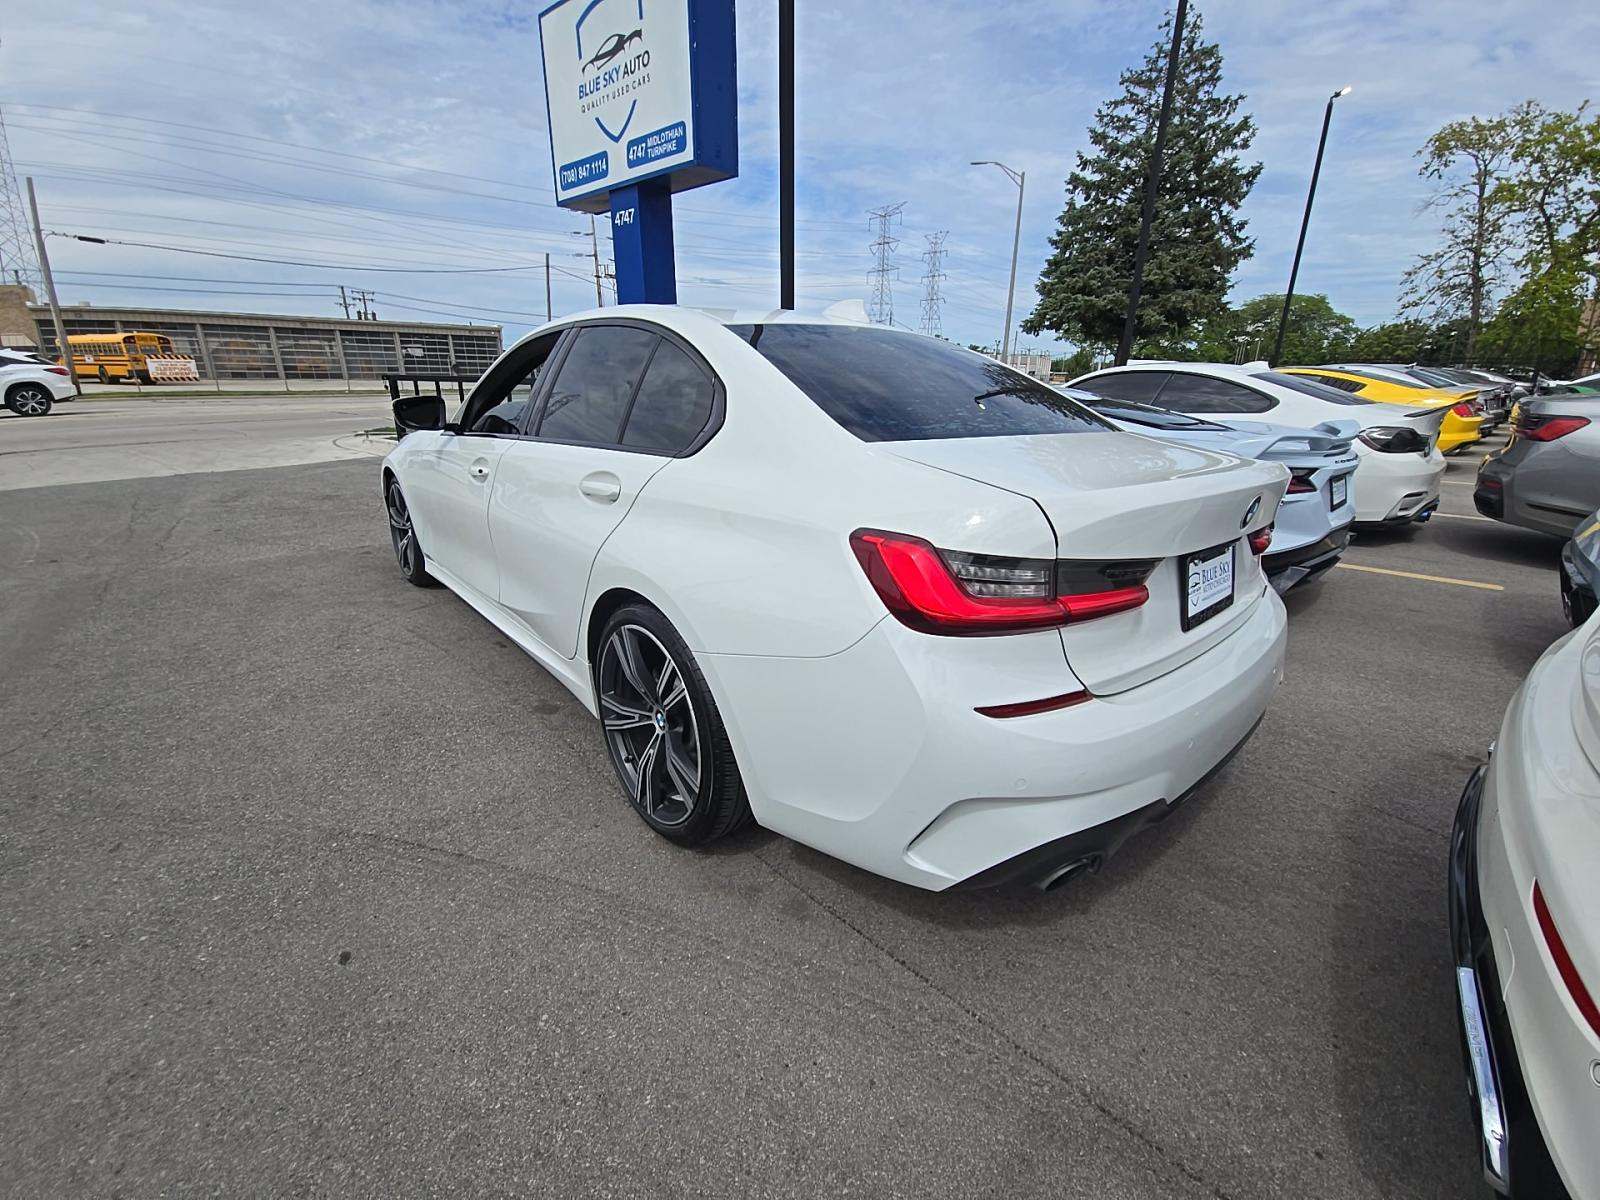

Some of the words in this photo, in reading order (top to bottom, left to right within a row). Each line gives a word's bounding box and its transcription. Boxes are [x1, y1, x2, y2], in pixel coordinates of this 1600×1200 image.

[579, 76, 600, 99] BLUE
[603, 65, 620, 88] SKY
[623, 50, 650, 79] AUTO
[581, 95, 609, 113] QUALITY
[612, 84, 629, 99] USED
[632, 73, 650, 89] CARS
[647, 126, 683, 147] MIDLOTHIAN
[629, 143, 646, 160] 4747
[648, 140, 677, 158] TURNPIKE
[579, 163, 590, 179] 847
[592, 158, 606, 174] 1114
[615, 208, 635, 226] 4747
[1202, 567, 1217, 584] BLUE
[1219, 561, 1230, 576] SKY
